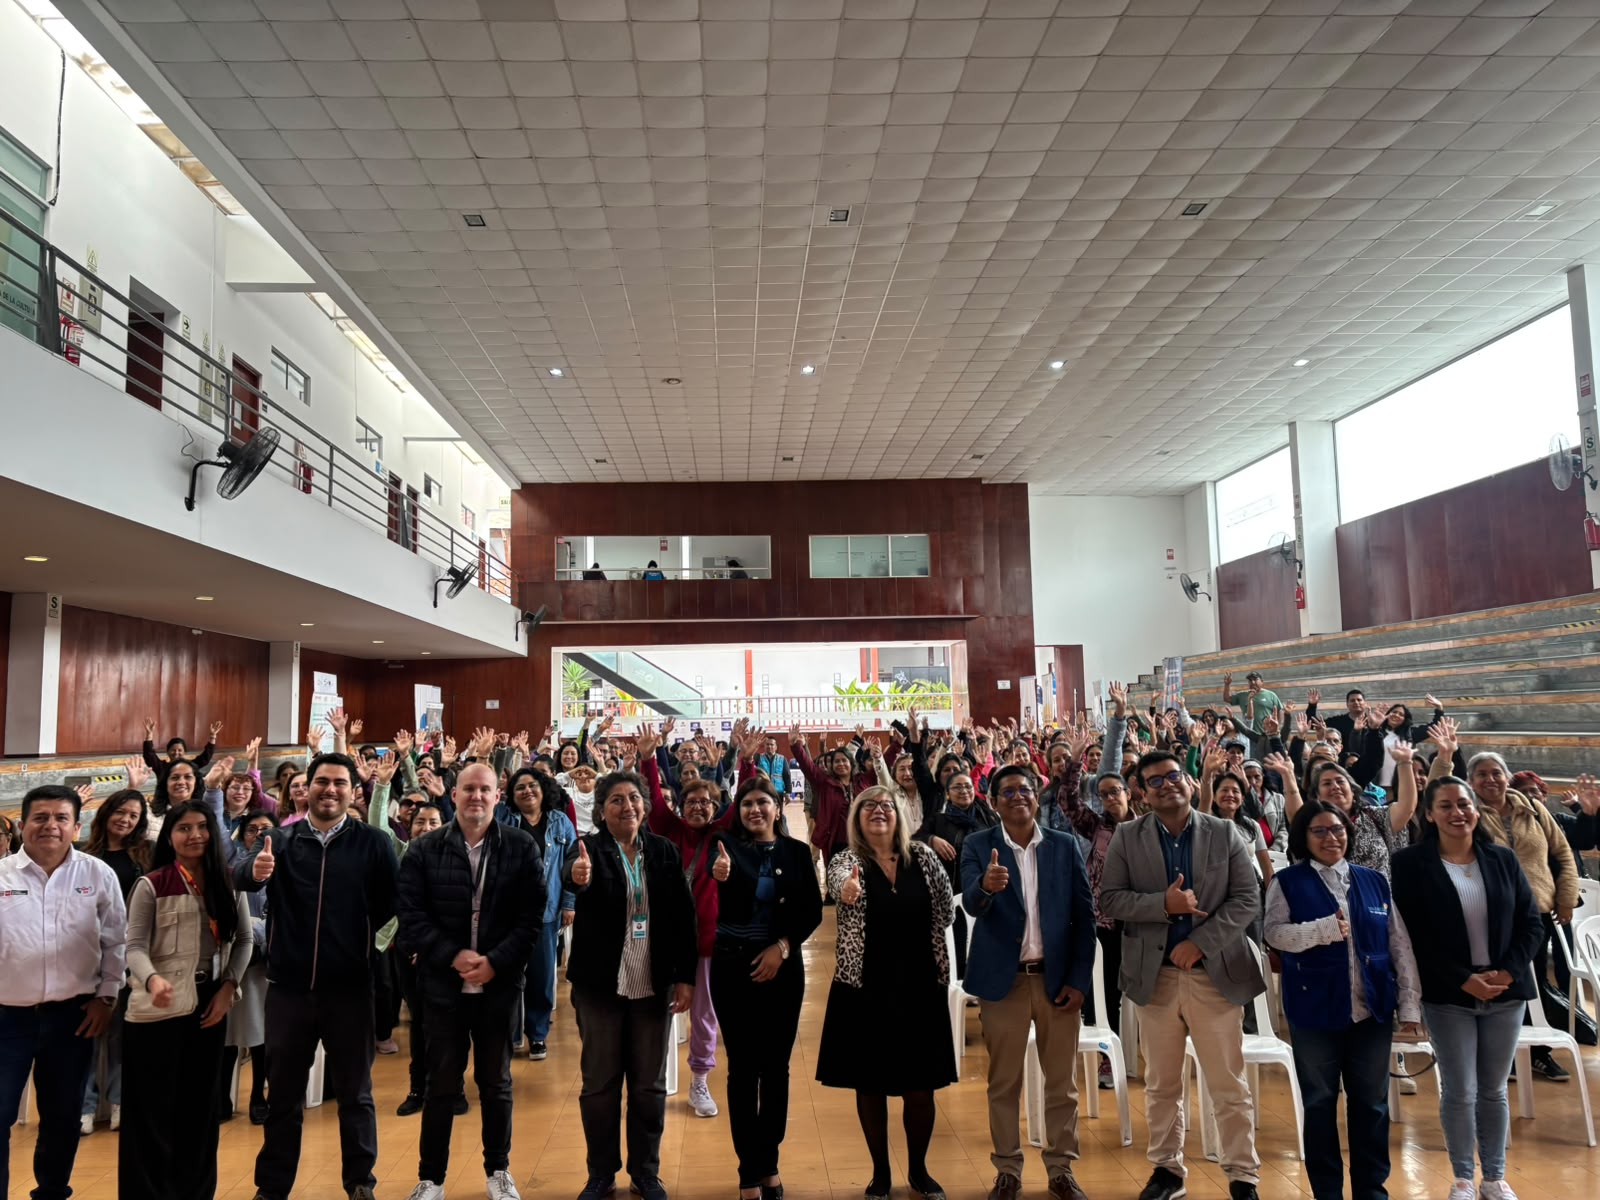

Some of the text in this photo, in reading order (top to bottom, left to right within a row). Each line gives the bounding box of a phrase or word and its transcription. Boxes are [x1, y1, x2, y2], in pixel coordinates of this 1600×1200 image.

[9, 295, 16, 305] LA
[1586, 436, 1594, 449] S
[51, 596, 58, 609] S
